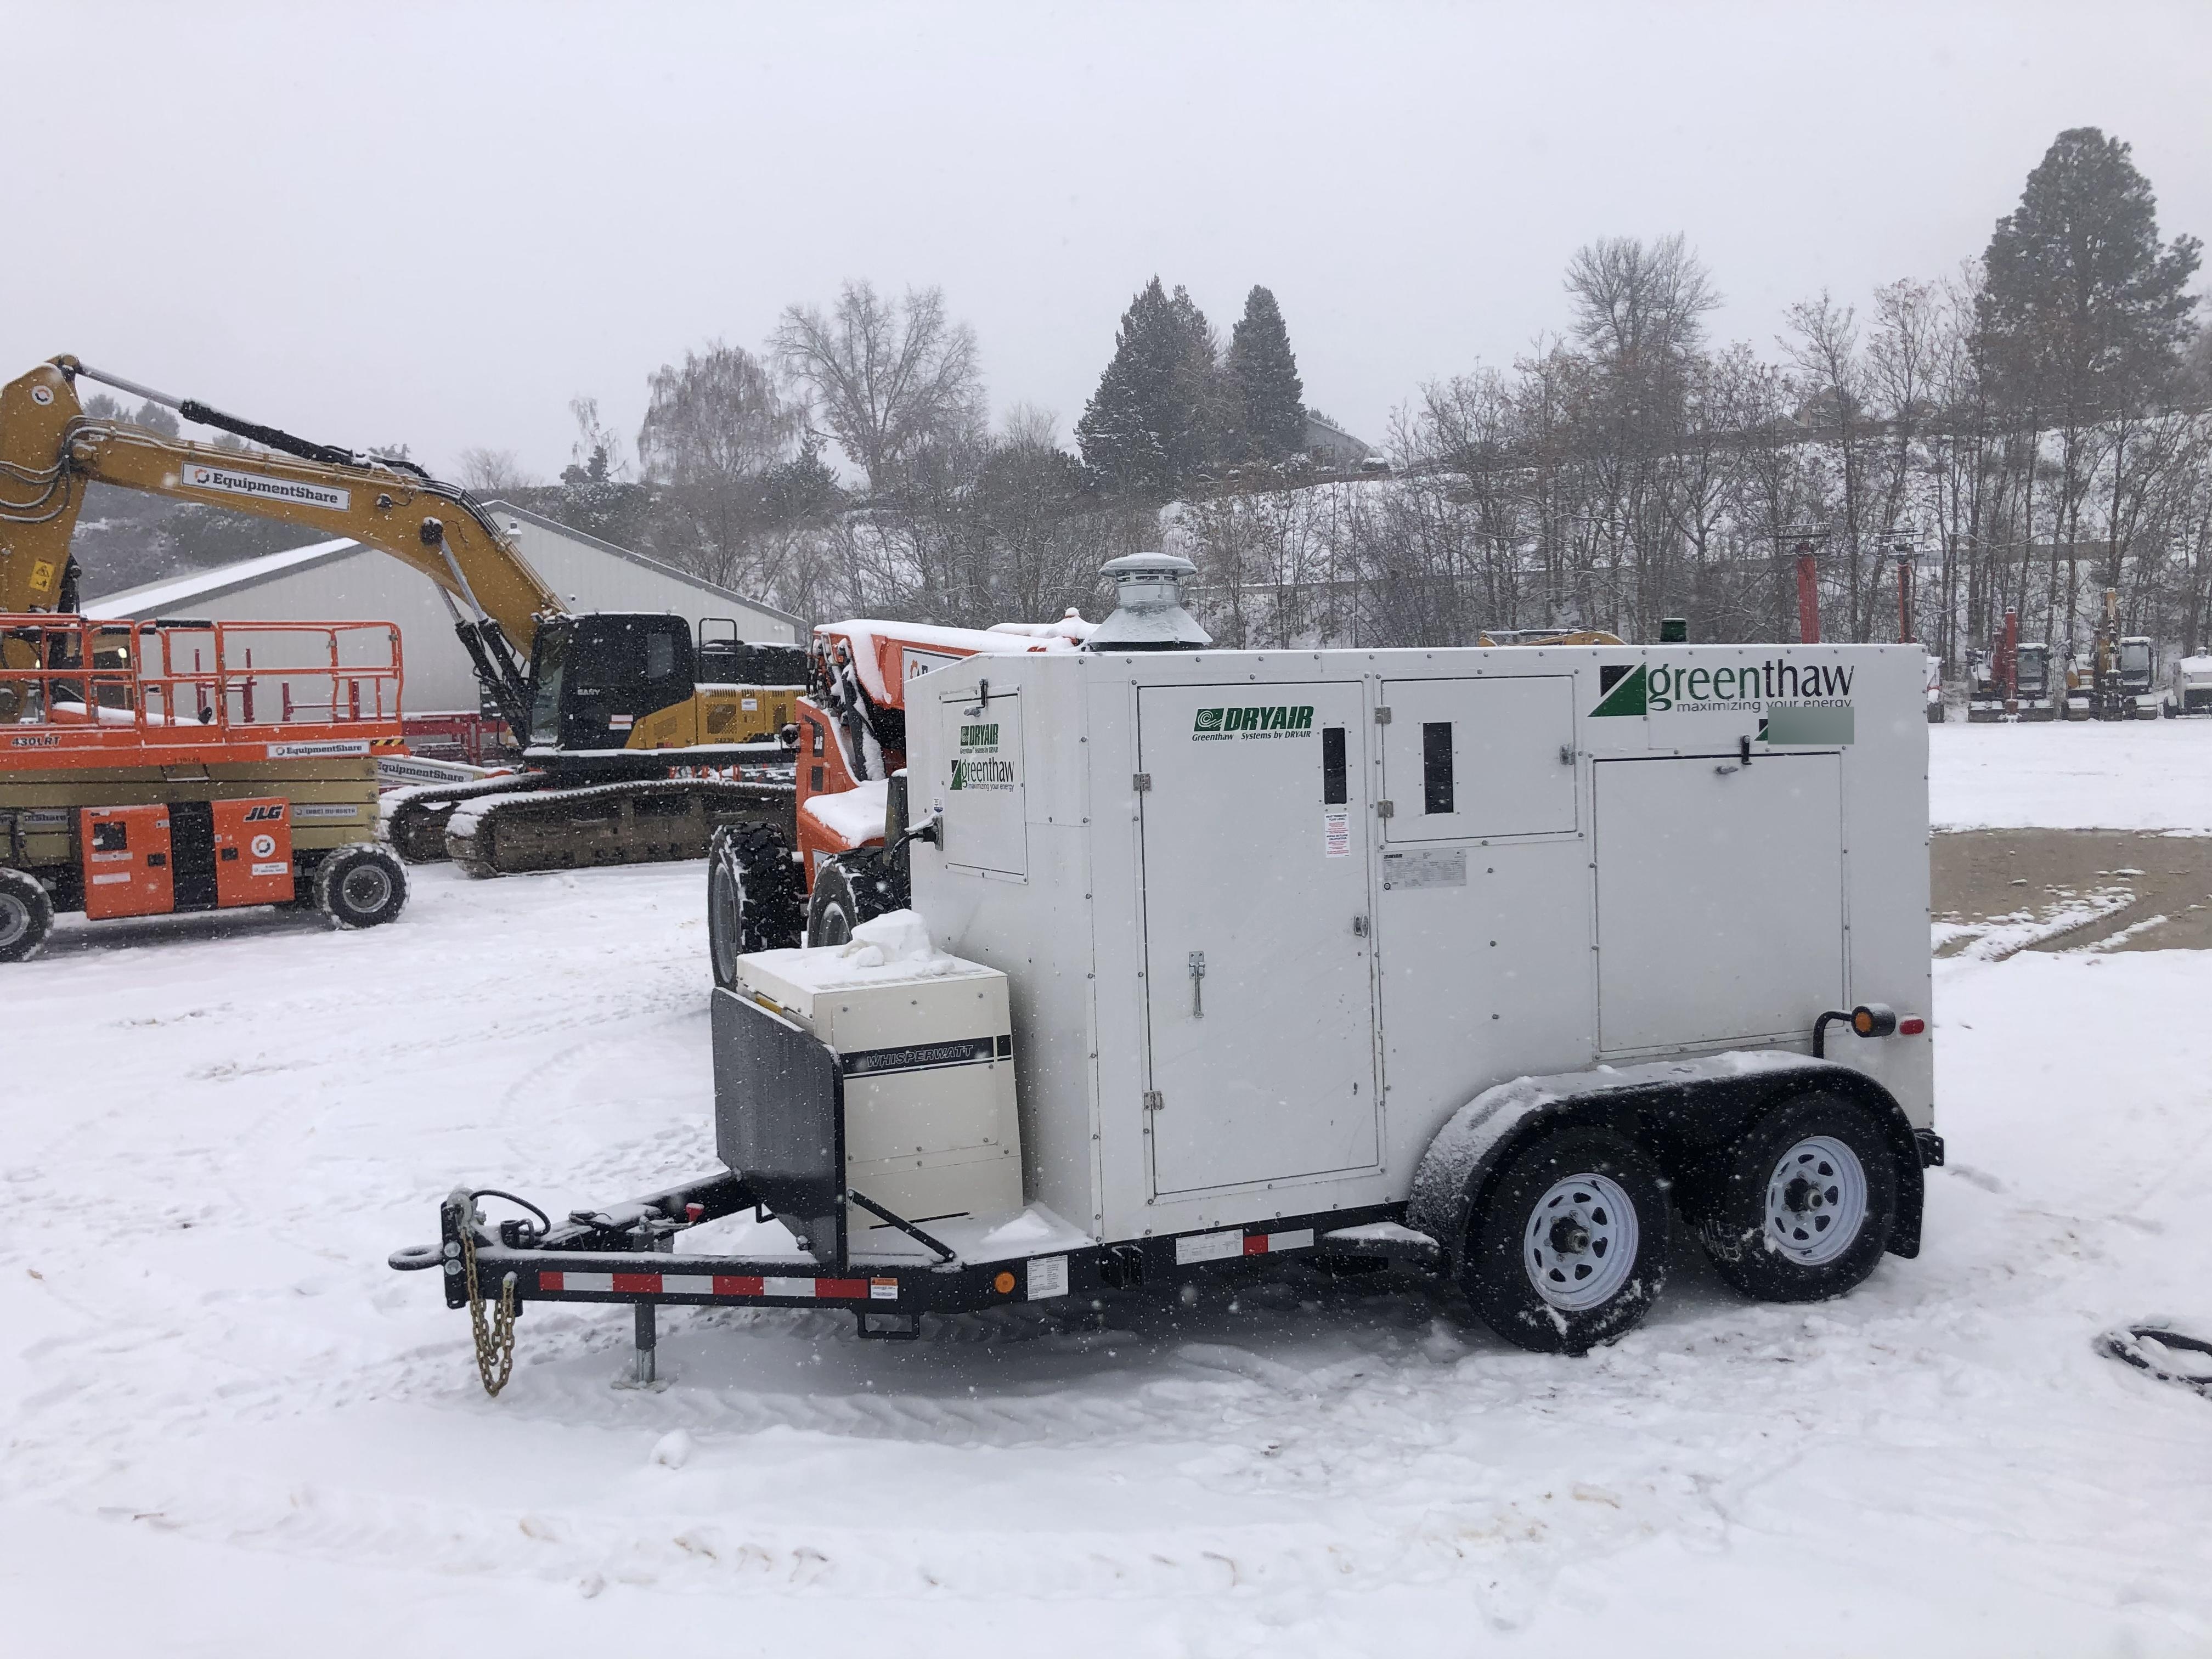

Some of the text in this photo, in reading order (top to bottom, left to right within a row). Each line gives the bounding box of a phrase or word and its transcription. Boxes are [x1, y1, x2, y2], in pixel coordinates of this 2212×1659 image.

[213, 472, 338, 503] EquipmentShare
[1648, 659, 1855, 712] greenthaw
[1677, 700, 1760, 713] maximizing
[1223, 706, 1314, 731] DRYAIR
[969, 724, 998, 746] DRYAIR
[1274, 731, 1283, 740] by
[286, 744, 362, 755] EquipmentShare
[962, 757, 1014, 788] greenthaw
[1000, 783, 1014, 792] energy
[245, 806, 283, 821] JLG
[867, 1045, 973, 1068] WHISPERWATT
